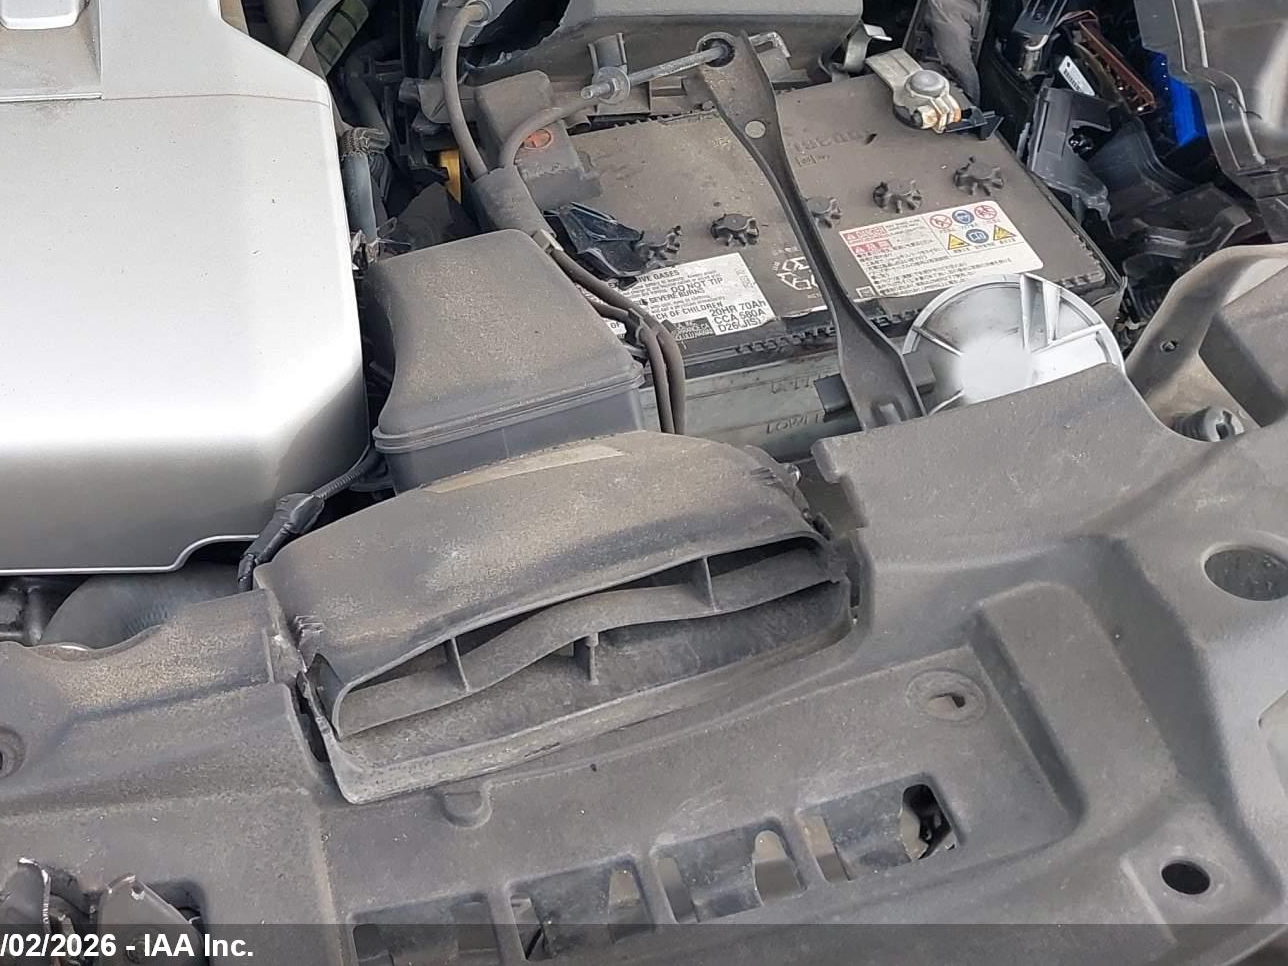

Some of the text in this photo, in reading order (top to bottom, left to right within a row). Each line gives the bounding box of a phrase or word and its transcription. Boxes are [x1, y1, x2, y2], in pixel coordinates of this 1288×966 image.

[670, 285, 686, 293] DO
[686, 280, 706, 289] NOT
[708, 277, 724, 285] TIP
[648, 293, 679, 304] SEVERE
[678, 288, 705, 298] BURNS
[682, 301, 724, 315] CHILDREN
[711, 305, 738, 317] 20HR
[738, 299, 767, 311] 70Ah
[714, 314, 740, 325] CCA
[718, 317, 762, 332] D26(JIS)
